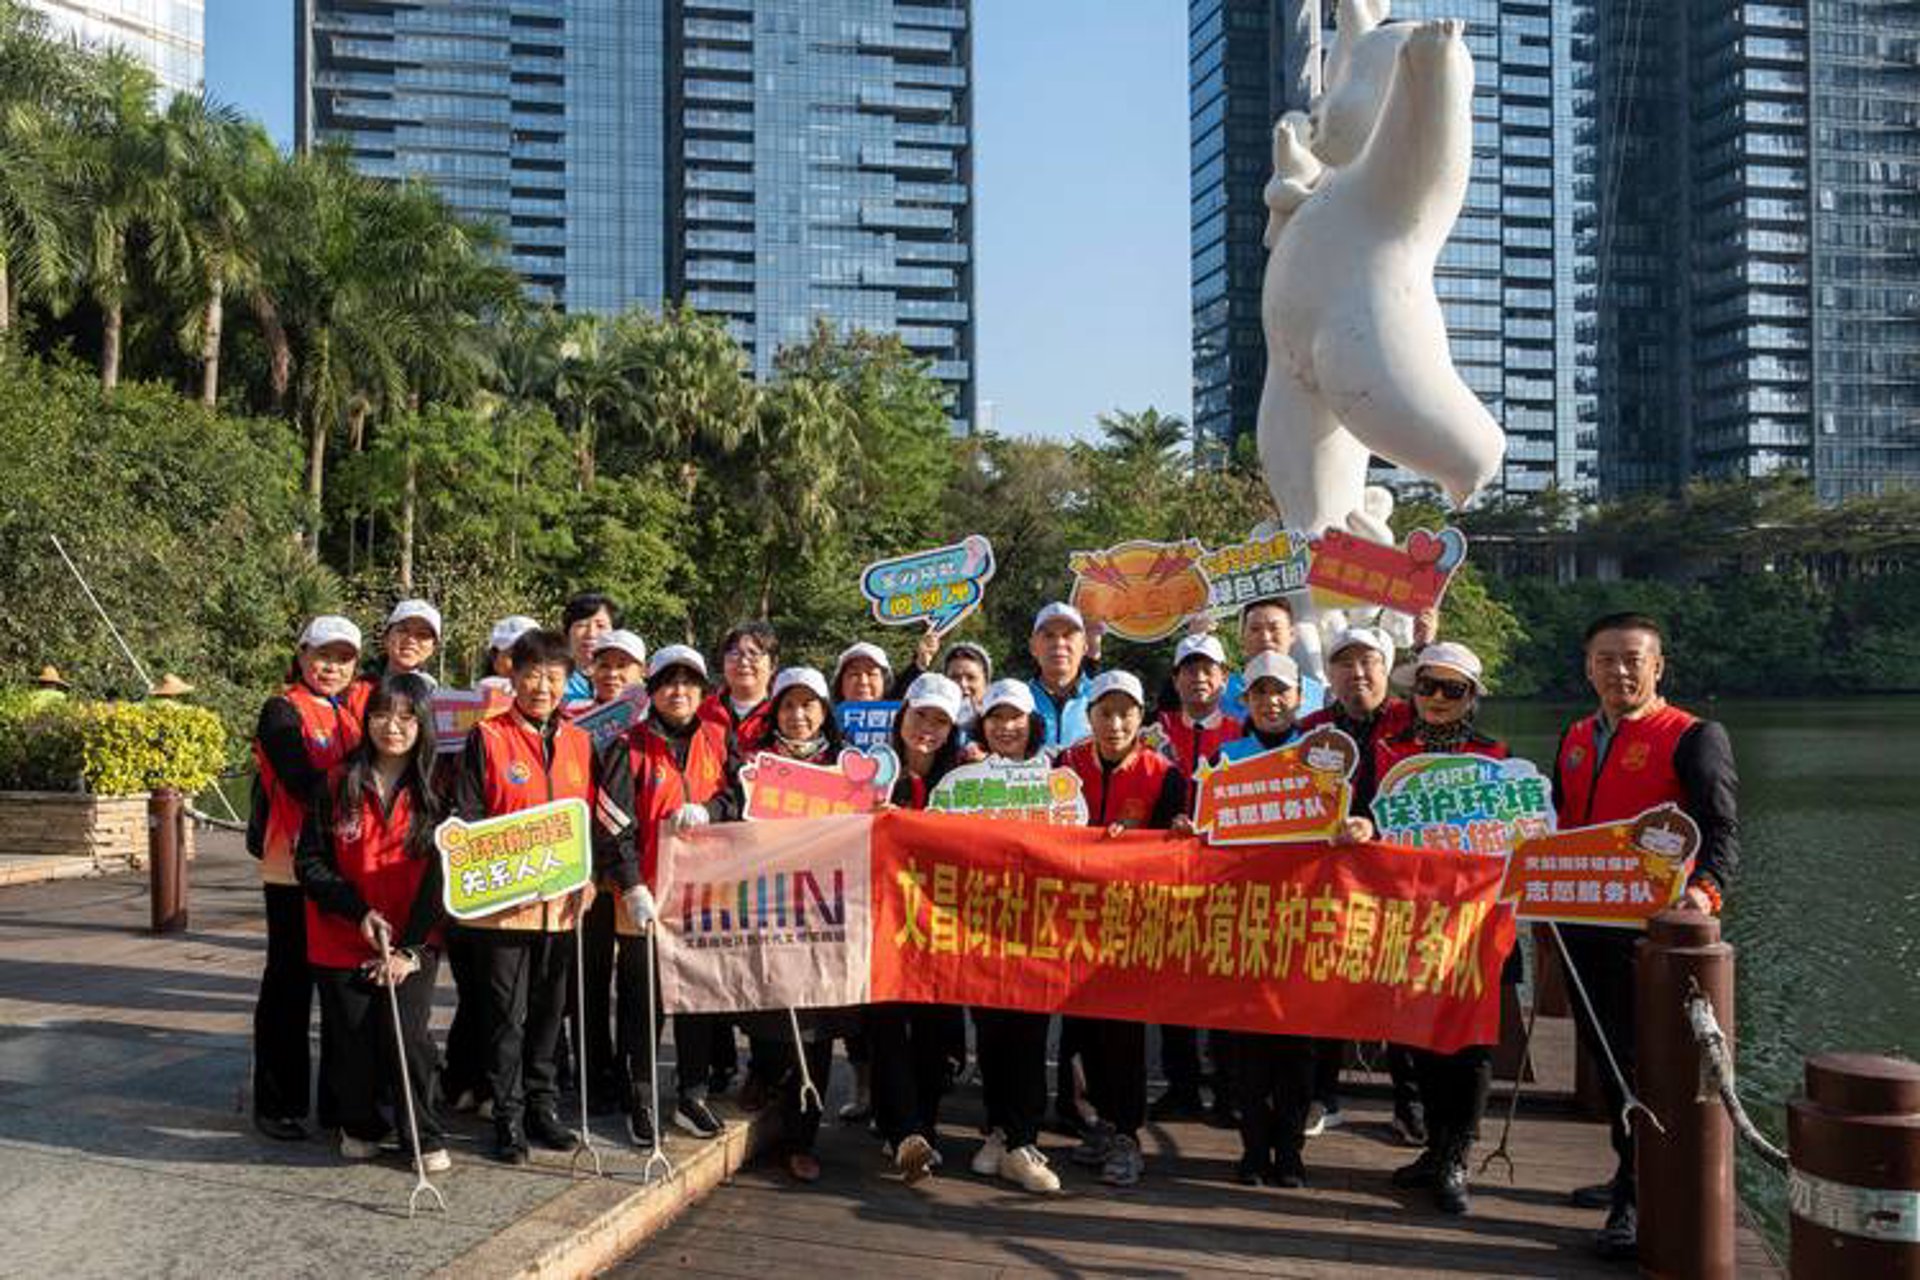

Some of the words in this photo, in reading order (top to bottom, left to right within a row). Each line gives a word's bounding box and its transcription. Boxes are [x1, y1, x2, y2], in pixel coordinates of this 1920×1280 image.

[1217, 795, 1328, 828] 志愿服务队
[1374, 776, 1546, 831] 保护环境
[461, 849, 565, 897] 关系人人
[1524, 879, 1655, 903] 志愿服务队
[896, 857, 1485, 1000] 文昌街社区天鹅湖环境保护志愿服务队
